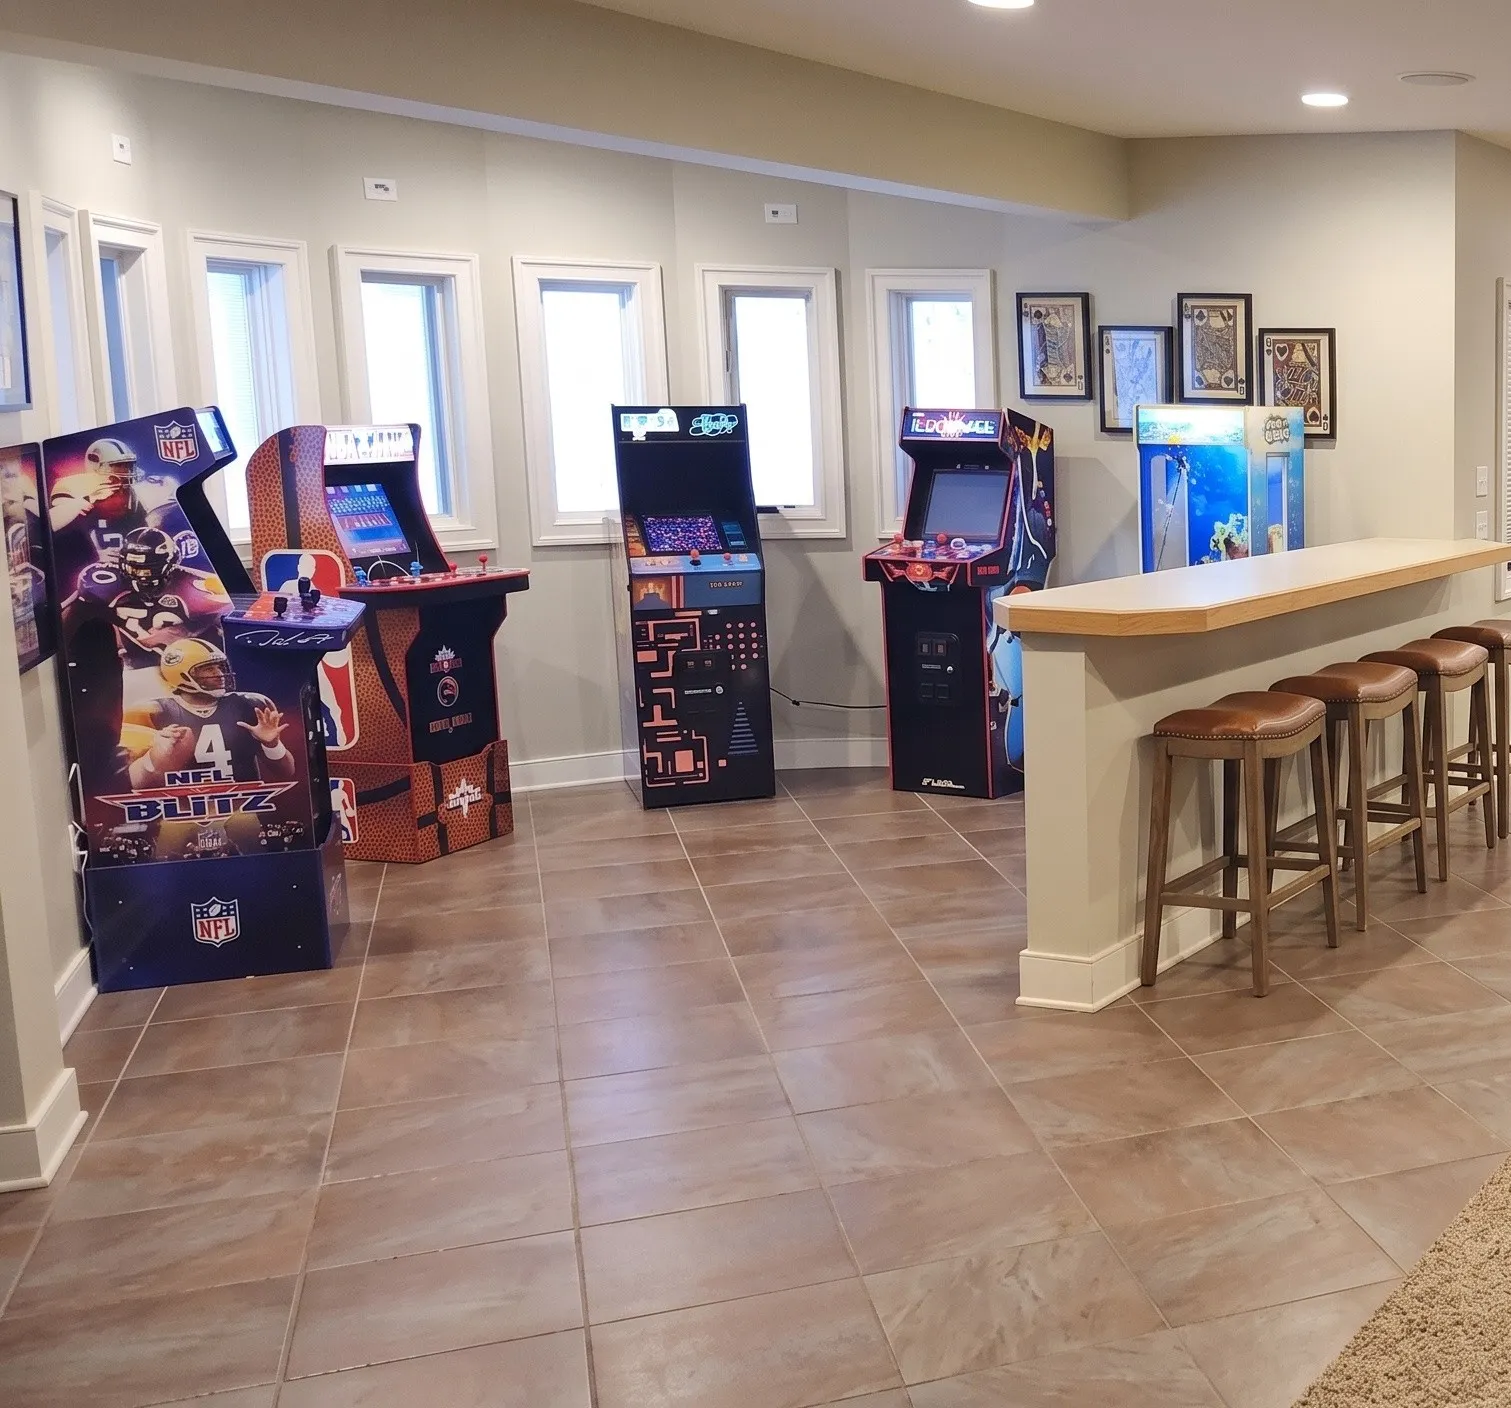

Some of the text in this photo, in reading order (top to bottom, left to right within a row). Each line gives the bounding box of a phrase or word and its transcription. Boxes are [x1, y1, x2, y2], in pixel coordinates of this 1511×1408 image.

[162, 440, 195, 459] NFL
[194, 723, 233, 777] 4
[165, 769, 236, 786] NFL
[125, 787, 280, 824] BLITZ
[198, 917, 235, 939] NFL
